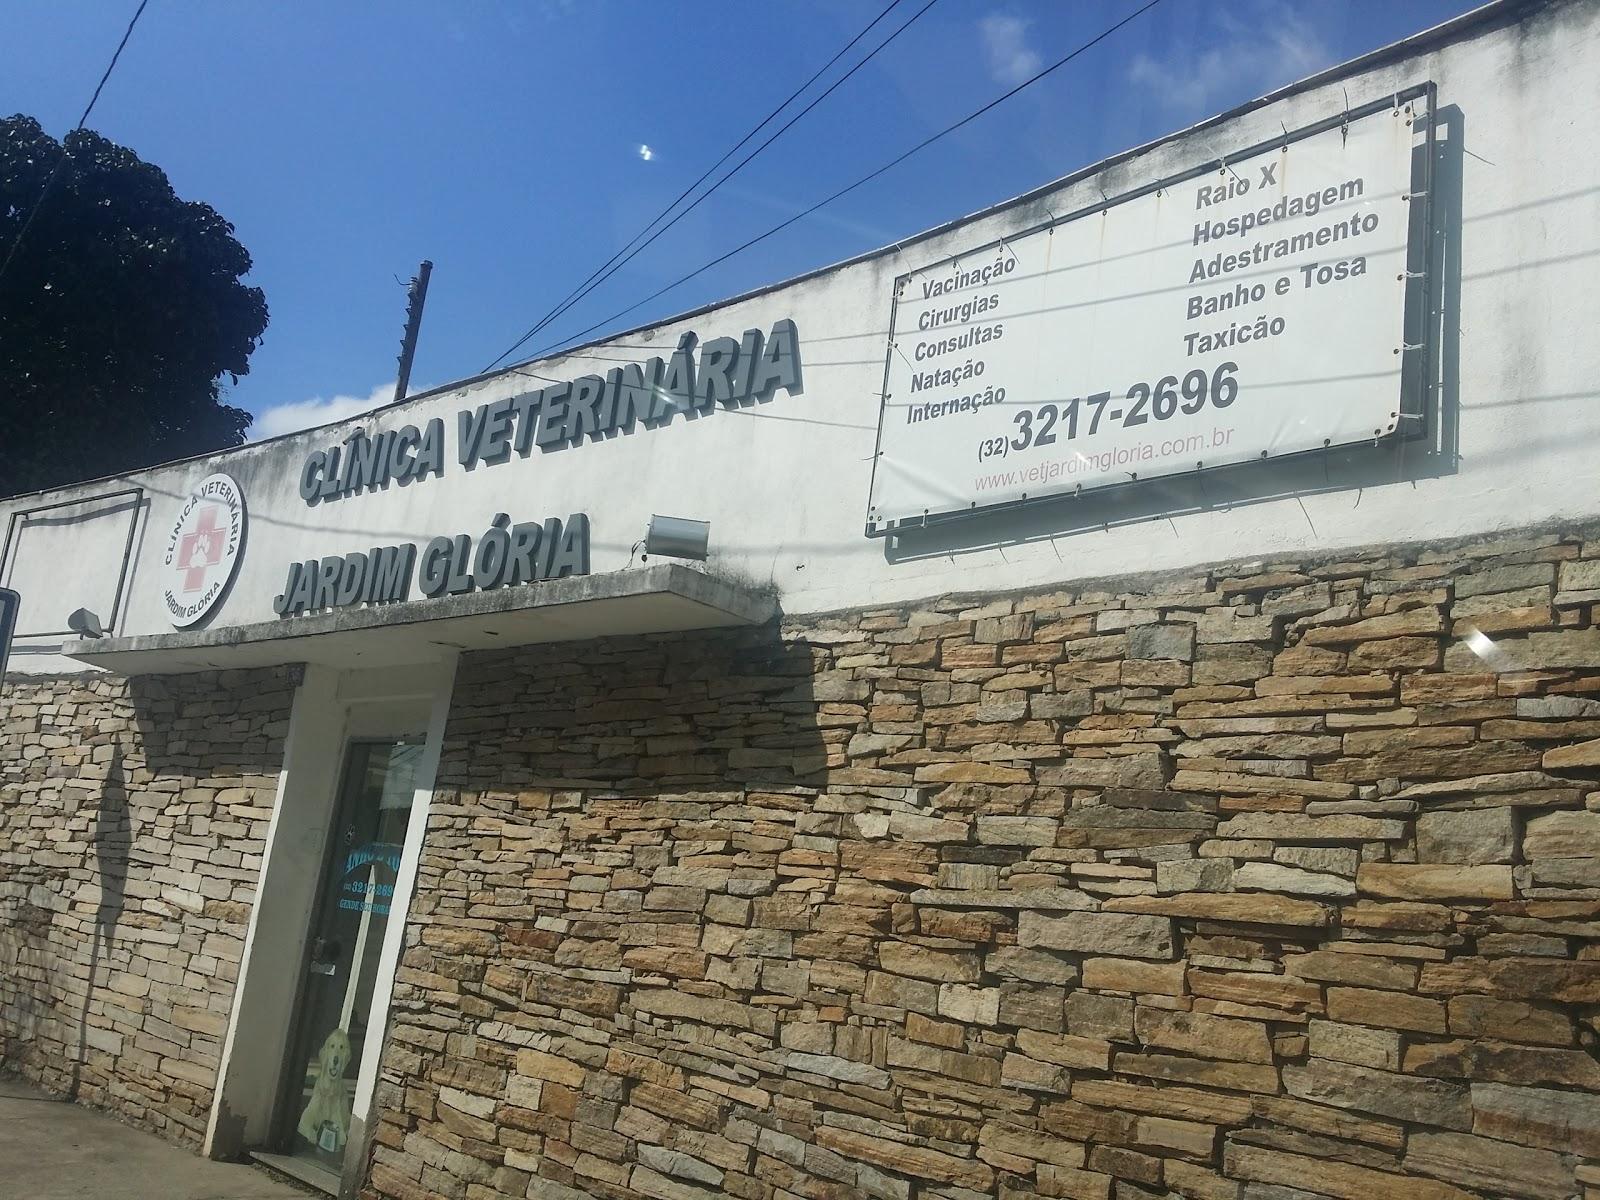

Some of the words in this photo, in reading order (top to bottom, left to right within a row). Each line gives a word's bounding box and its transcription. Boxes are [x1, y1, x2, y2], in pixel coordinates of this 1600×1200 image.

[1196, 177, 1250, 209] Raio
[1258, 162, 1278, 189] X
[1193, 178, 1364, 246] Hospedagem
[1189, 212, 1379, 283] Adestramento
[922, 257, 1016, 300] Vacinação
[1186, 284, 1266, 320] Banho
[1274, 276, 1291, 295] e
[1300, 256, 1367, 288] Tosa
[918, 293, 1000, 331] Cirurgias
[1183, 315, 1286, 356] Taxicão
[915, 324, 1004, 361] Consultas
[910, 358, 985, 393] Natação
[299, 418, 444, 507] CLÍNICA
[457, 318, 804, 472] VETERINÁRIA
[906, 385, 1006, 424] Internação
[974, 427, 1235, 492] www.vetjardimgloria.com.br
[201, 481, 240, 556] VETERINÁRIA
[274, 543, 416, 618] JARDIM
[419, 512, 590, 599] GLÓRIA
[165, 589, 187, 618] JARDIM
